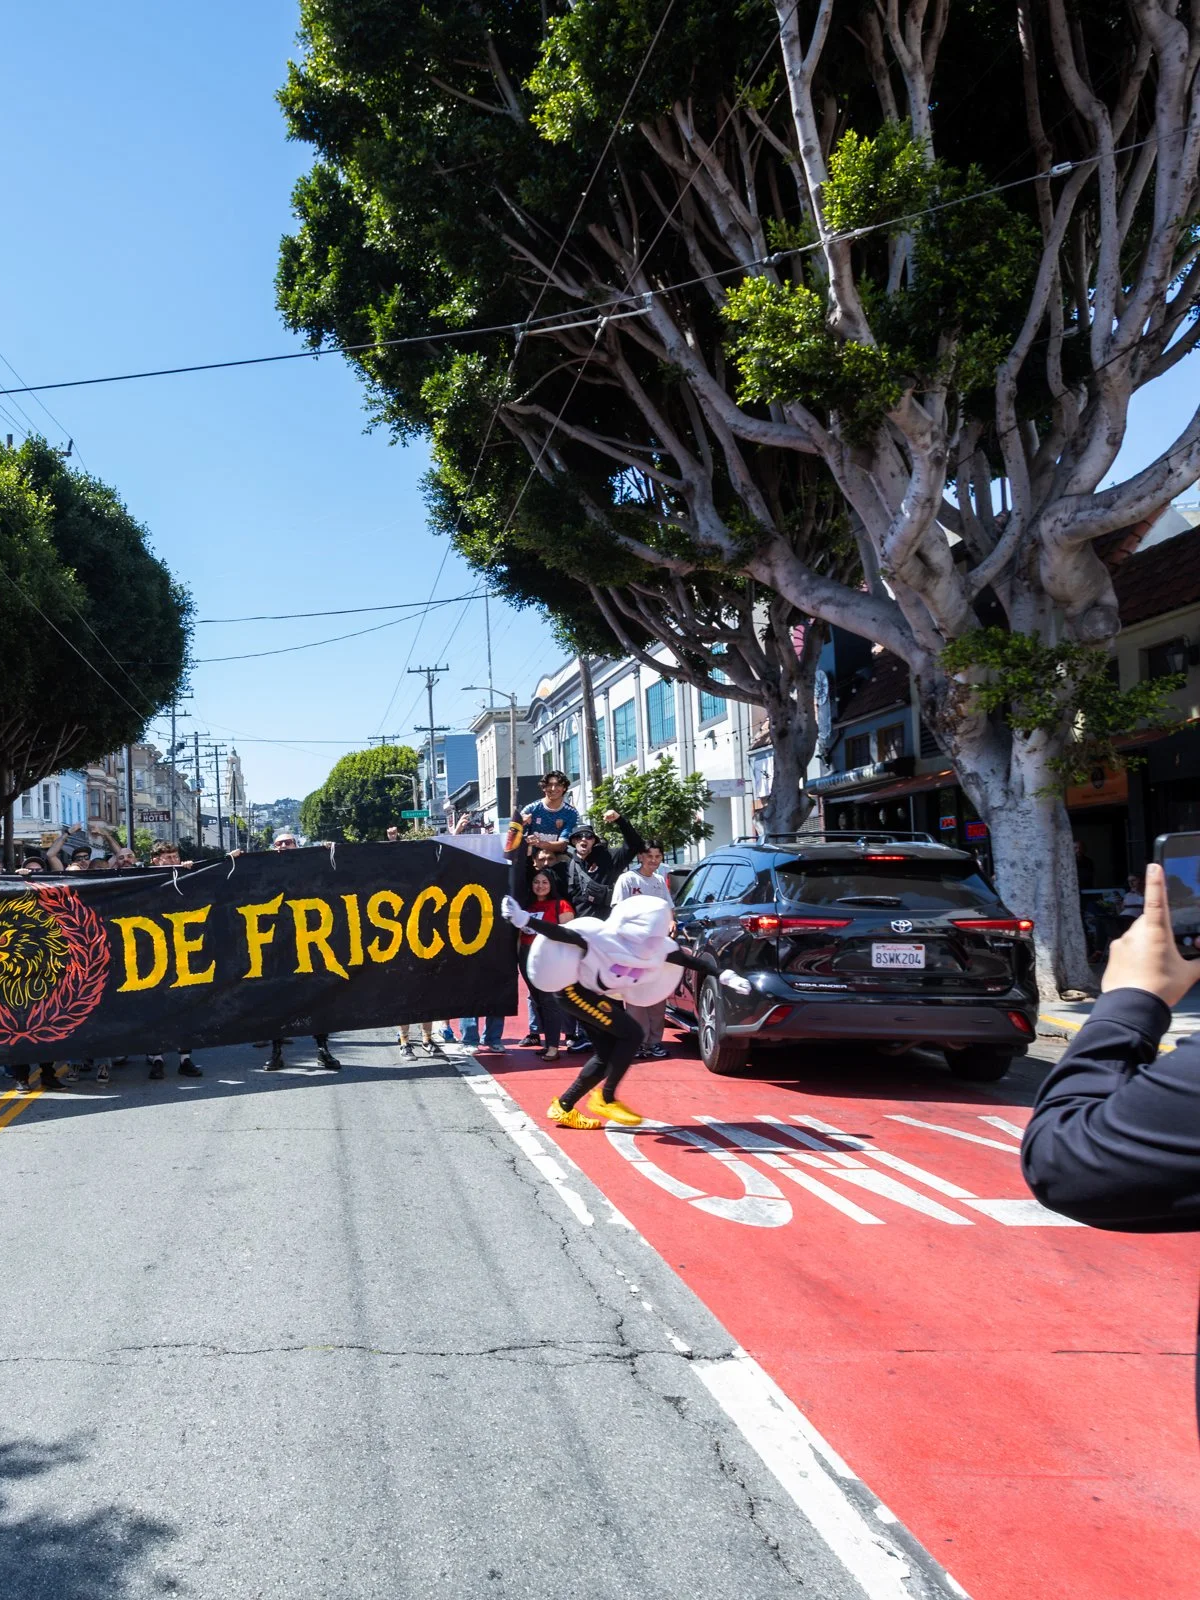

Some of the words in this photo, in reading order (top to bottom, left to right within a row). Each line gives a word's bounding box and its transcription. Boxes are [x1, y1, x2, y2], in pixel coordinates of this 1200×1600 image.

[143, 814, 169, 822] HOTEL
[110, 903, 217, 993] DE
[237, 882, 494, 981] FRISCO
[875, 952, 922, 965] 8SWK204
